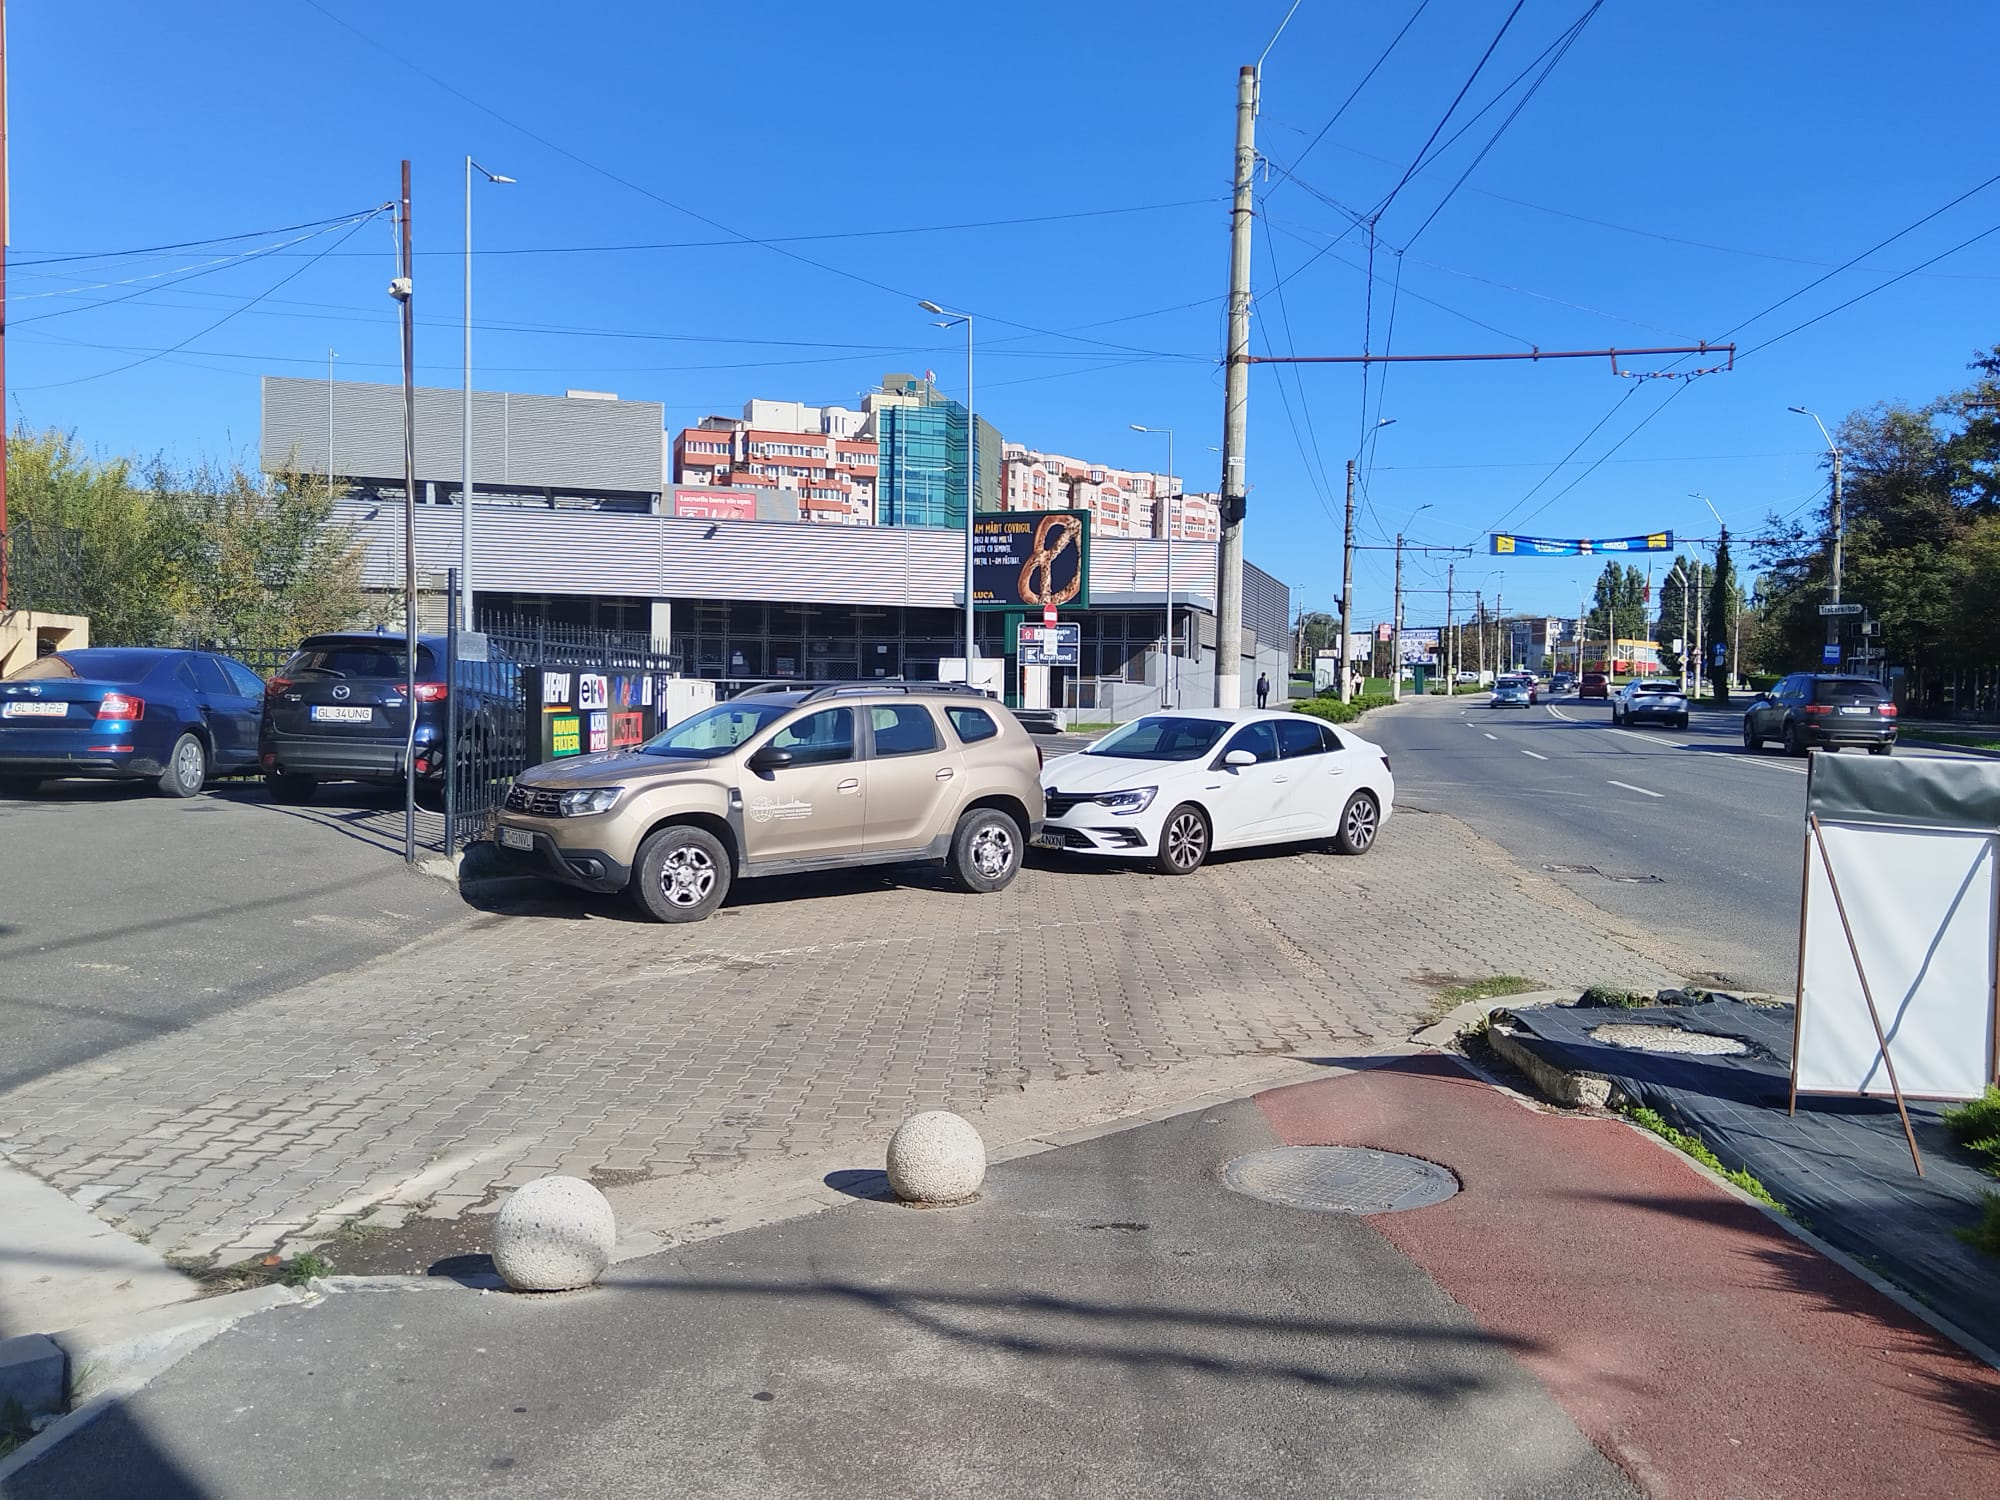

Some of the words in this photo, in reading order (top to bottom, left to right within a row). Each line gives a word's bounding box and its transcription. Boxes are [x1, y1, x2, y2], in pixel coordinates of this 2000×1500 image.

[975, 524, 983, 534] AM
[544, 672, 570, 703] HEPU
[582, 679, 597, 704] elf
[318, 709, 331, 718] GL
[554, 719, 579, 735] MANN
[615, 718, 639, 739] MOTUL
[553, 735, 579, 751] FILTER
